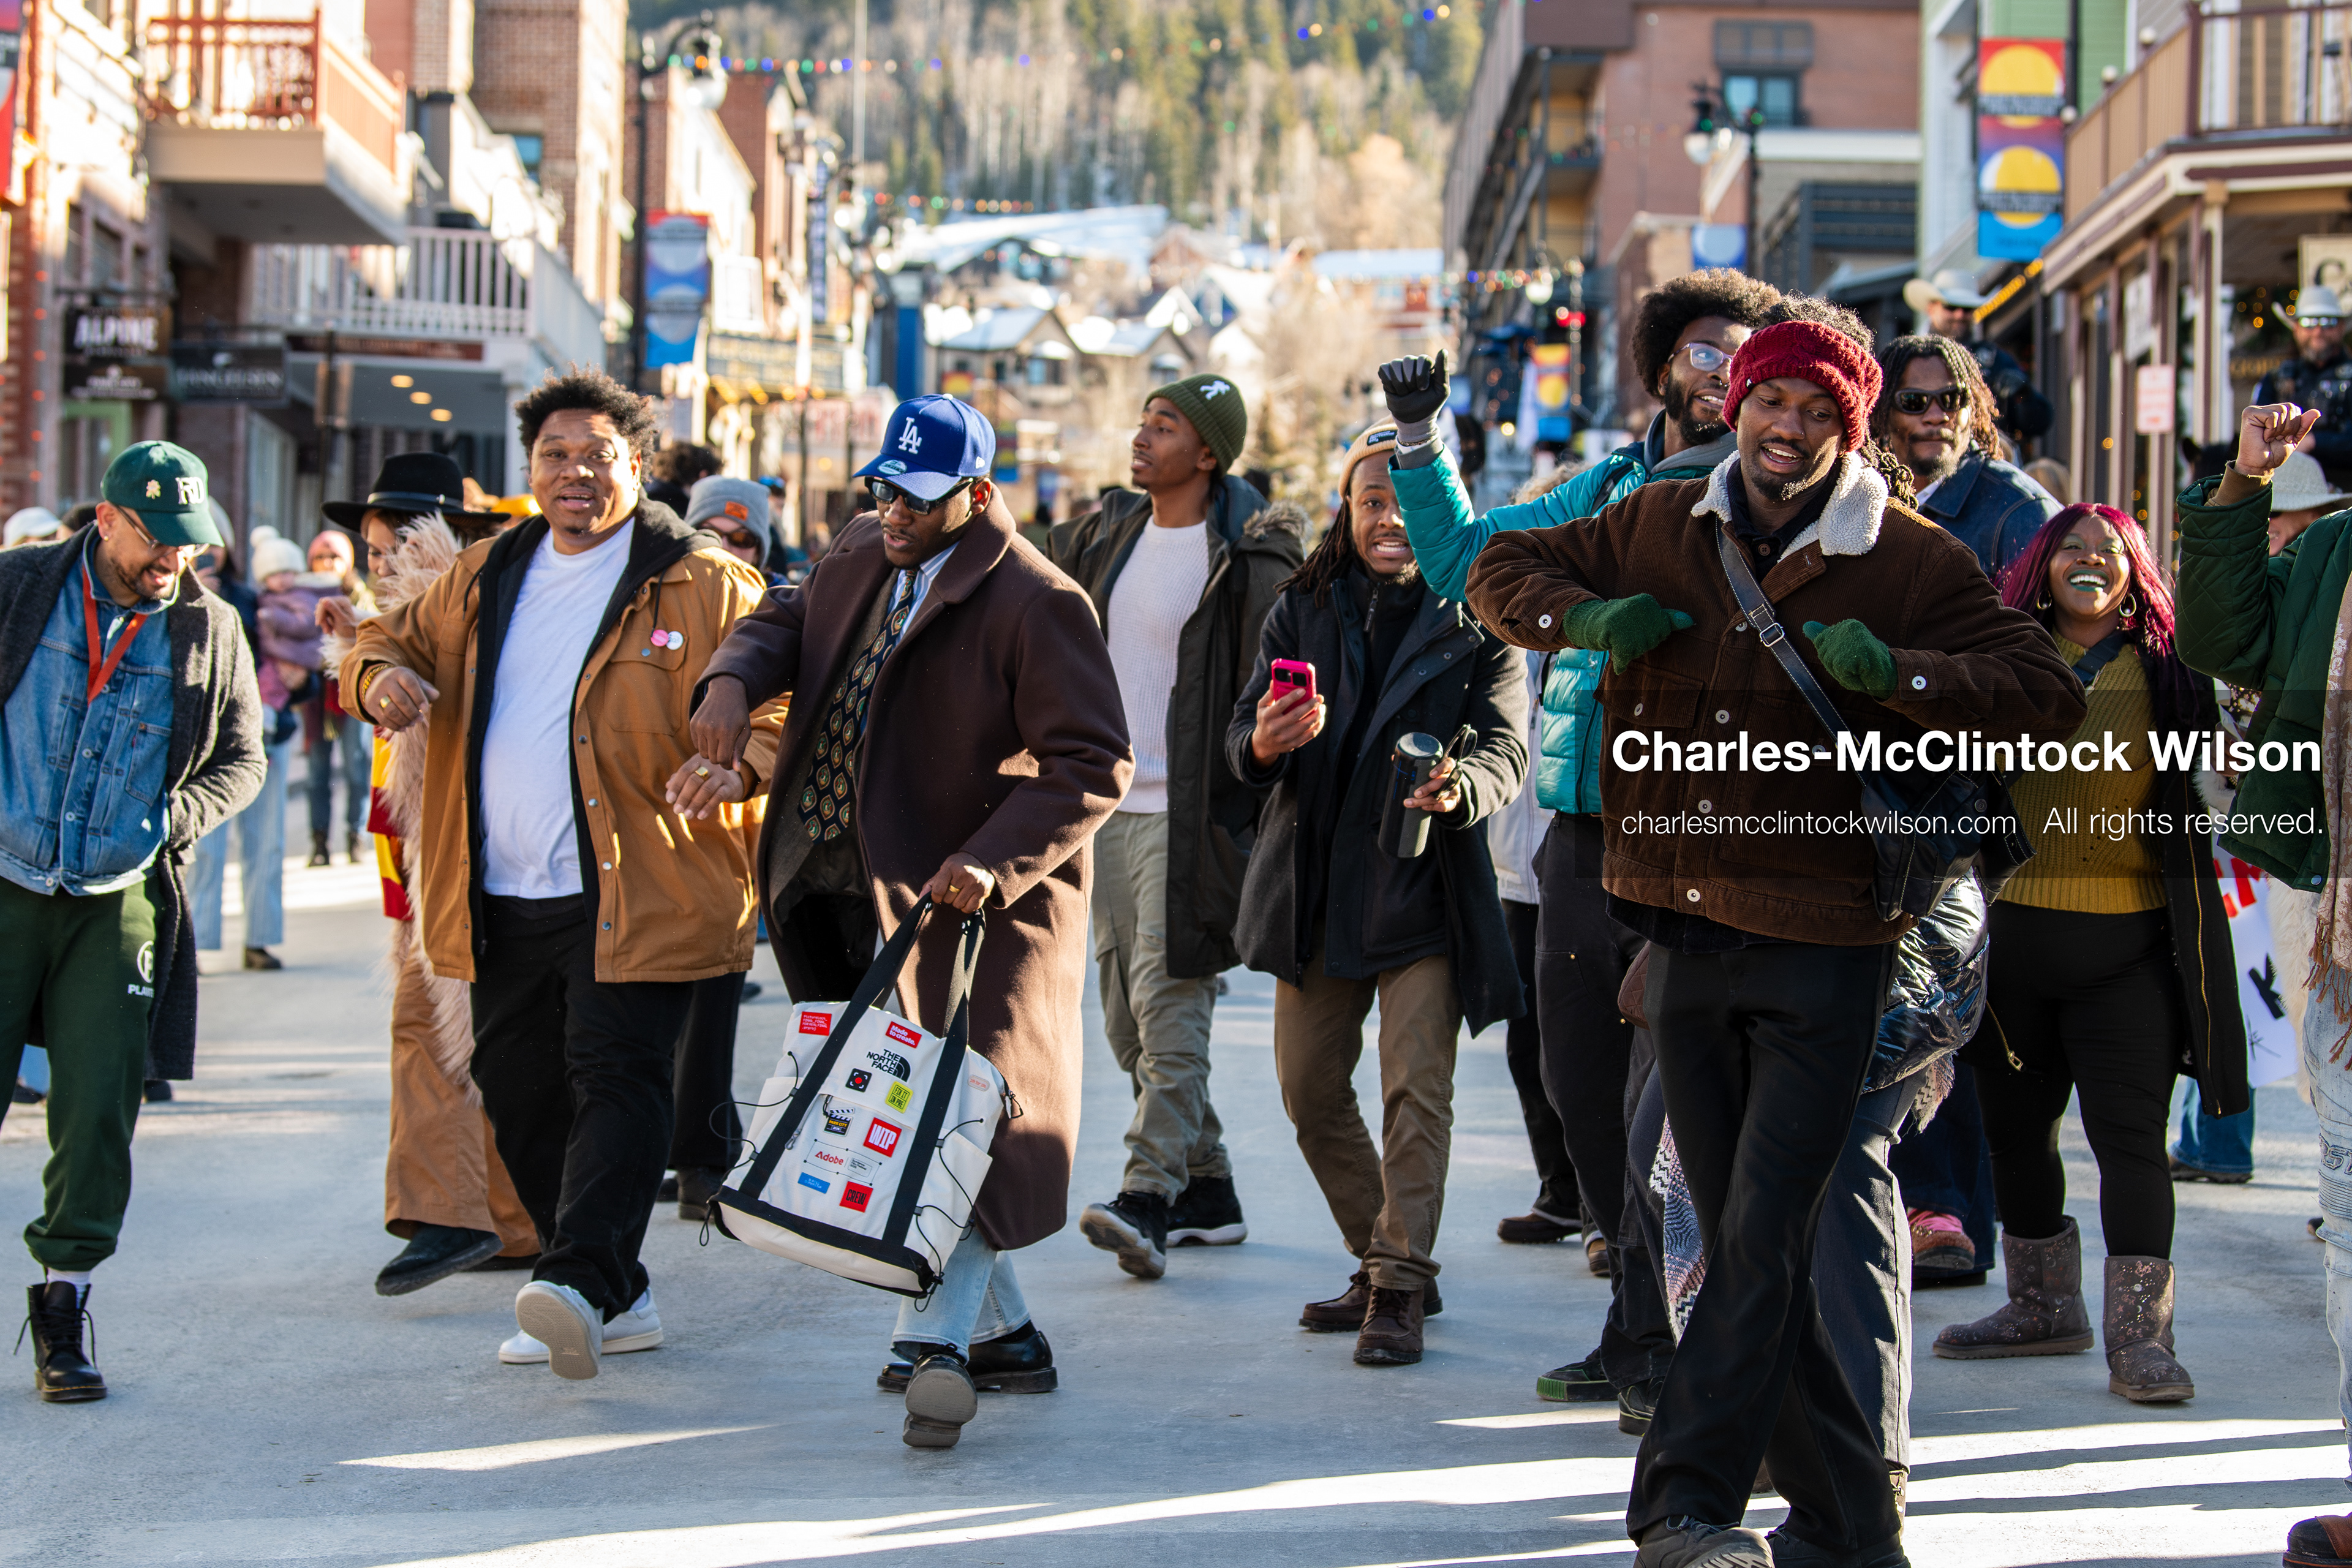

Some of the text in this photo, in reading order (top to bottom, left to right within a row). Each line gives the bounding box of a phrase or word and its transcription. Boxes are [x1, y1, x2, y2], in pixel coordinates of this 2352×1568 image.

[898, 417, 922, 454] LA
[891, 1025, 908, 1036] Made
[896, 1034, 916, 1046] create.
[866, 1051, 897, 1068] NORTH
[883, 1049, 901, 1062] THE
[871, 1060, 894, 1075] FACE
[901, 1091, 908, 1099] IT
[868, 1123, 897, 1150] WIP
[815, 1151, 843, 1165] Adobe
[846, 1189, 867, 1205] CREW
